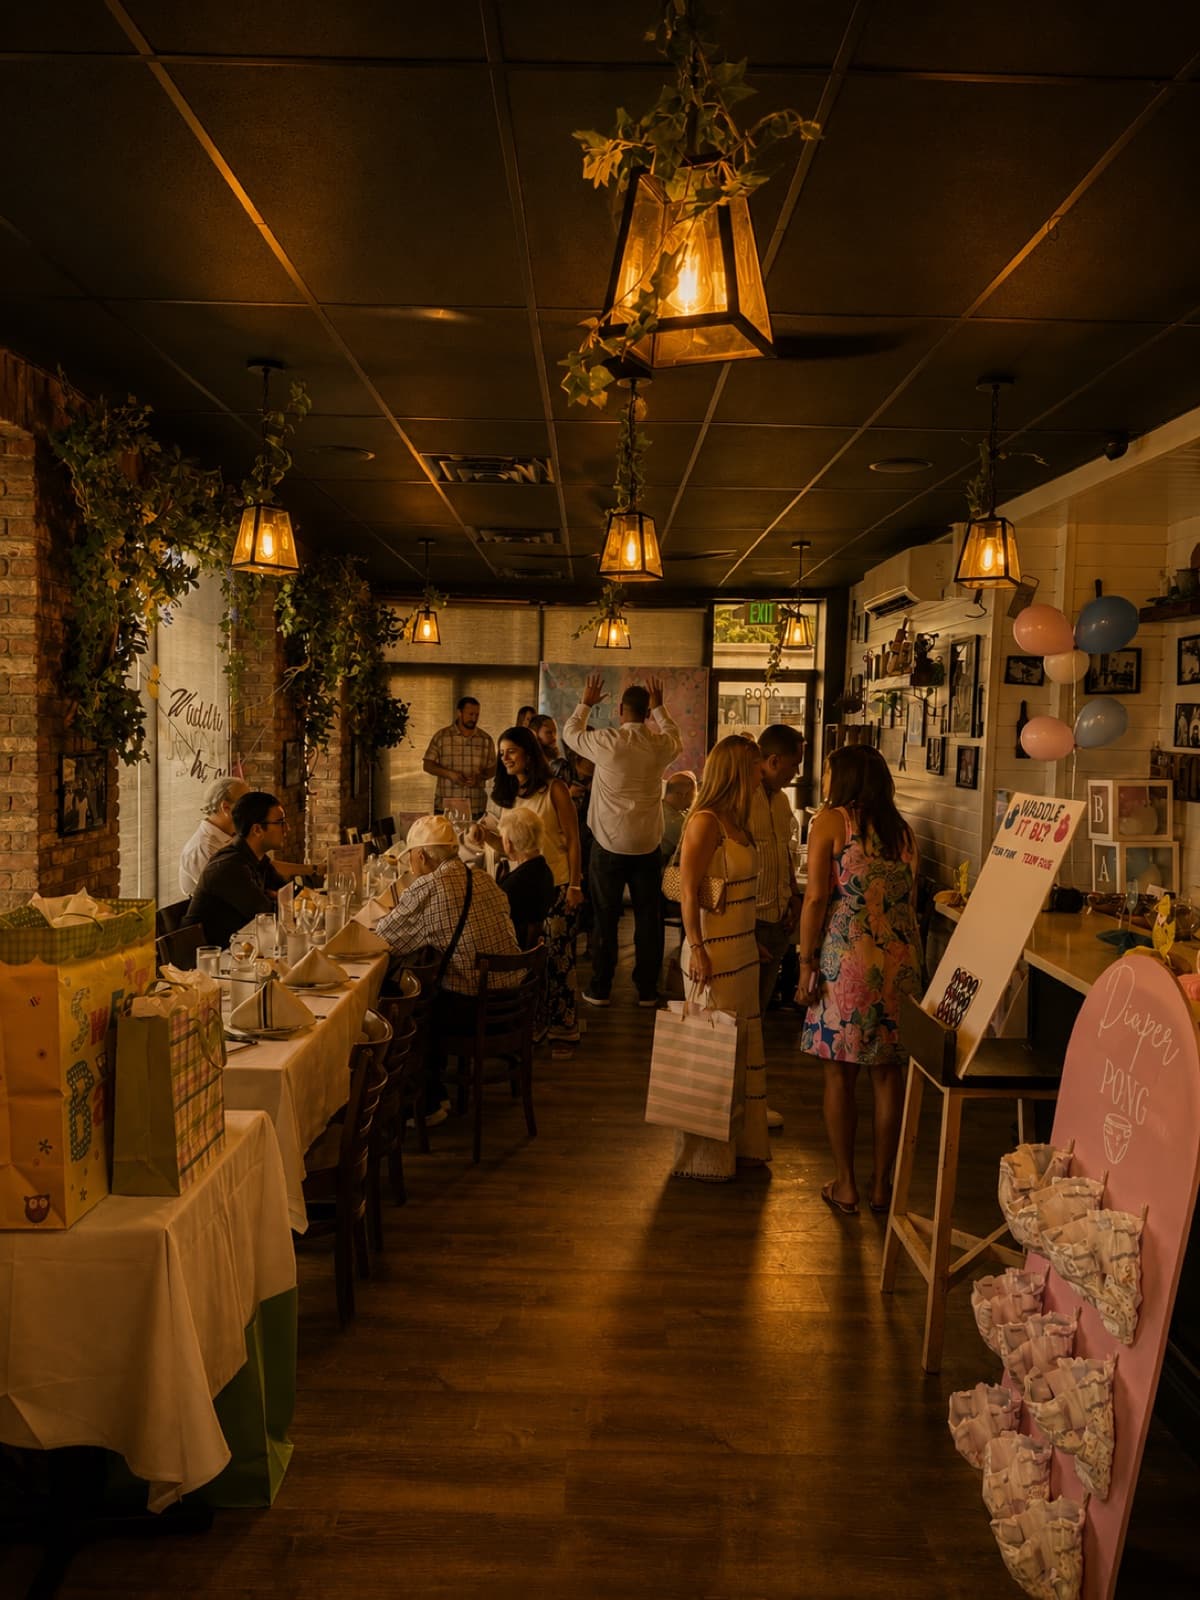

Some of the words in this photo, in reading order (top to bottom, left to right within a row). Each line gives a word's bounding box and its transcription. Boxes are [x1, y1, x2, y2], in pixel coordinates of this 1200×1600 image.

[750, 603, 775, 624] EXIT
[1020, 799, 1065, 822] WADDLE
[1092, 794, 1104, 823] B
[1015, 819, 1032, 837] IT
[1097, 855, 1110, 882] A
[1098, 964, 1180, 1072] Diaper
[1100, 1058, 1149, 1125] PONG
